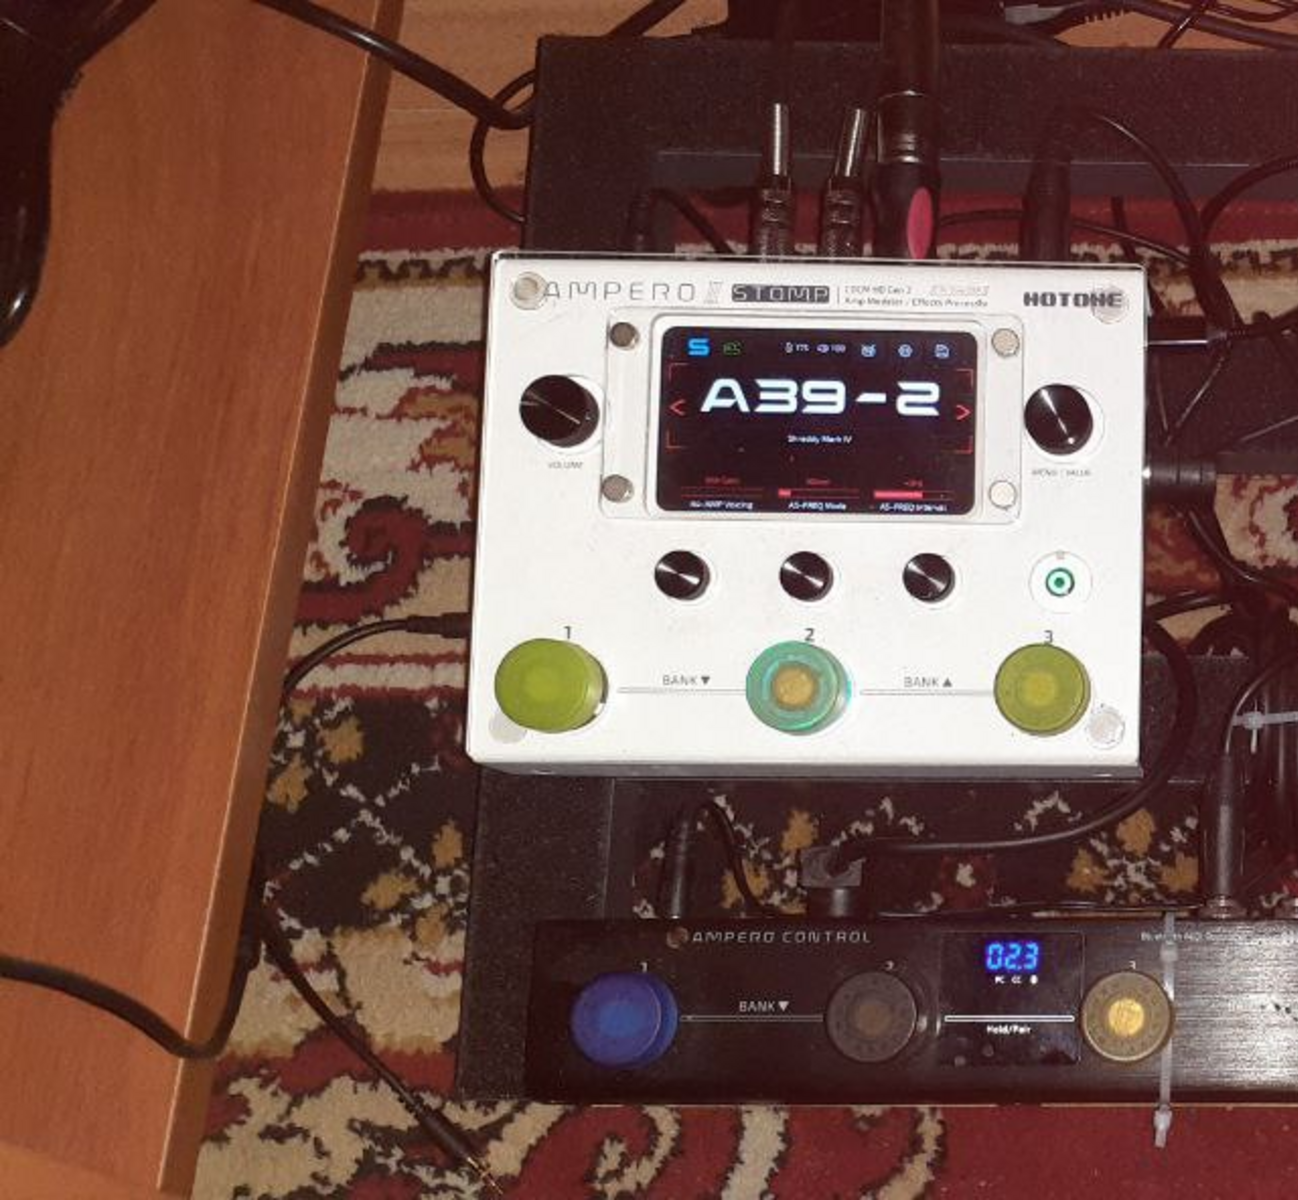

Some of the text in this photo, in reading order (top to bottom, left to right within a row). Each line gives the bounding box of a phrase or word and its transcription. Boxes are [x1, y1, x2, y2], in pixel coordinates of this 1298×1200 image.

[543, 281, 696, 301] AMPERO
[732, 284, 829, 302] STOMP
[1022, 291, 1123, 309] HOTONE
[563, 626, 572, 640] 1
[804, 628, 815, 642] 2
[1043, 630, 1054, 644] 3
[662, 675, 699, 686] BANK
[903, 677, 940, 688] BANK
[692, 931, 871, 944] AMPERO CONTROL
[739, 1000, 776, 1012] BANK
